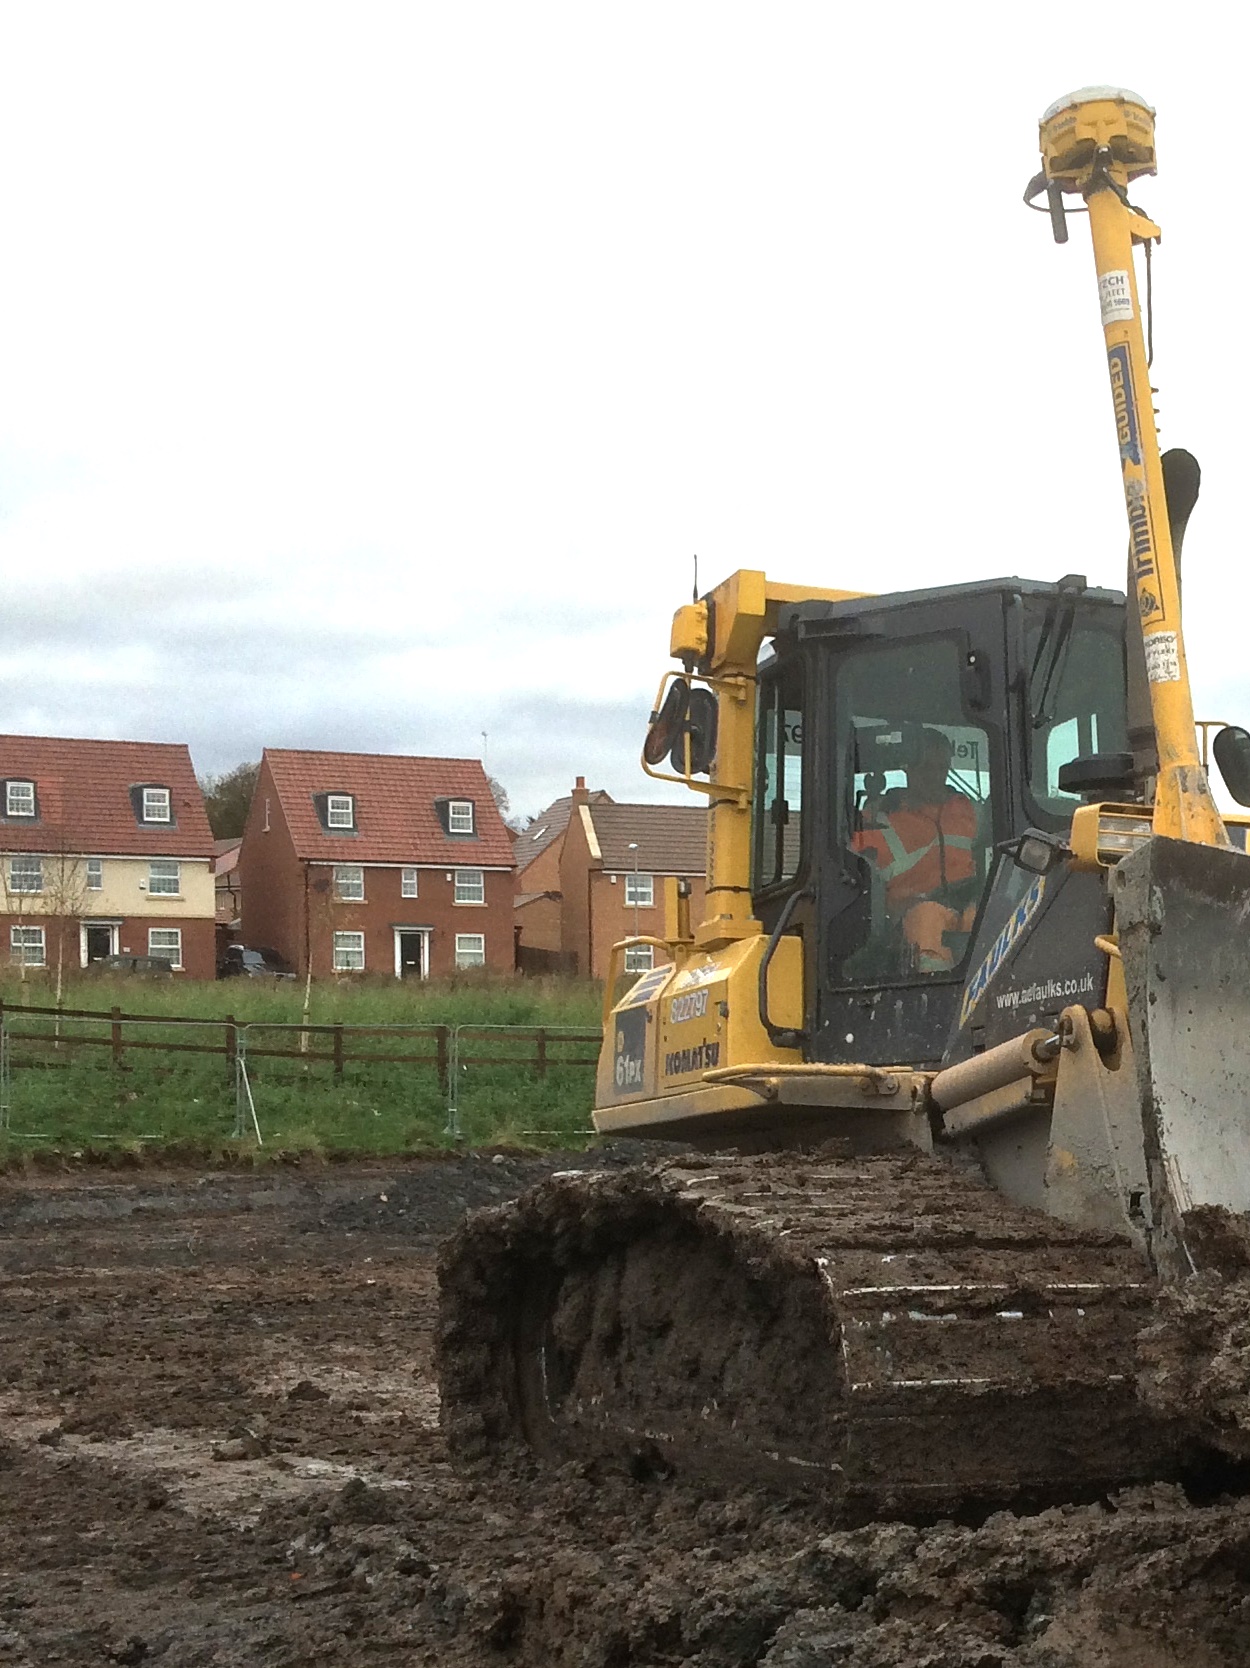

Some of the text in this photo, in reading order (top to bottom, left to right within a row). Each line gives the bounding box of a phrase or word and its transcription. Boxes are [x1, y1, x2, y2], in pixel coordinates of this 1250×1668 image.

[1109, 356, 1132, 446] GUIDED
[670, 988, 709, 1025] 822797
[996, 972, 1094, 1009] www.aefaulks.co.uk
[664, 1037, 720, 1077] KOMATSU
